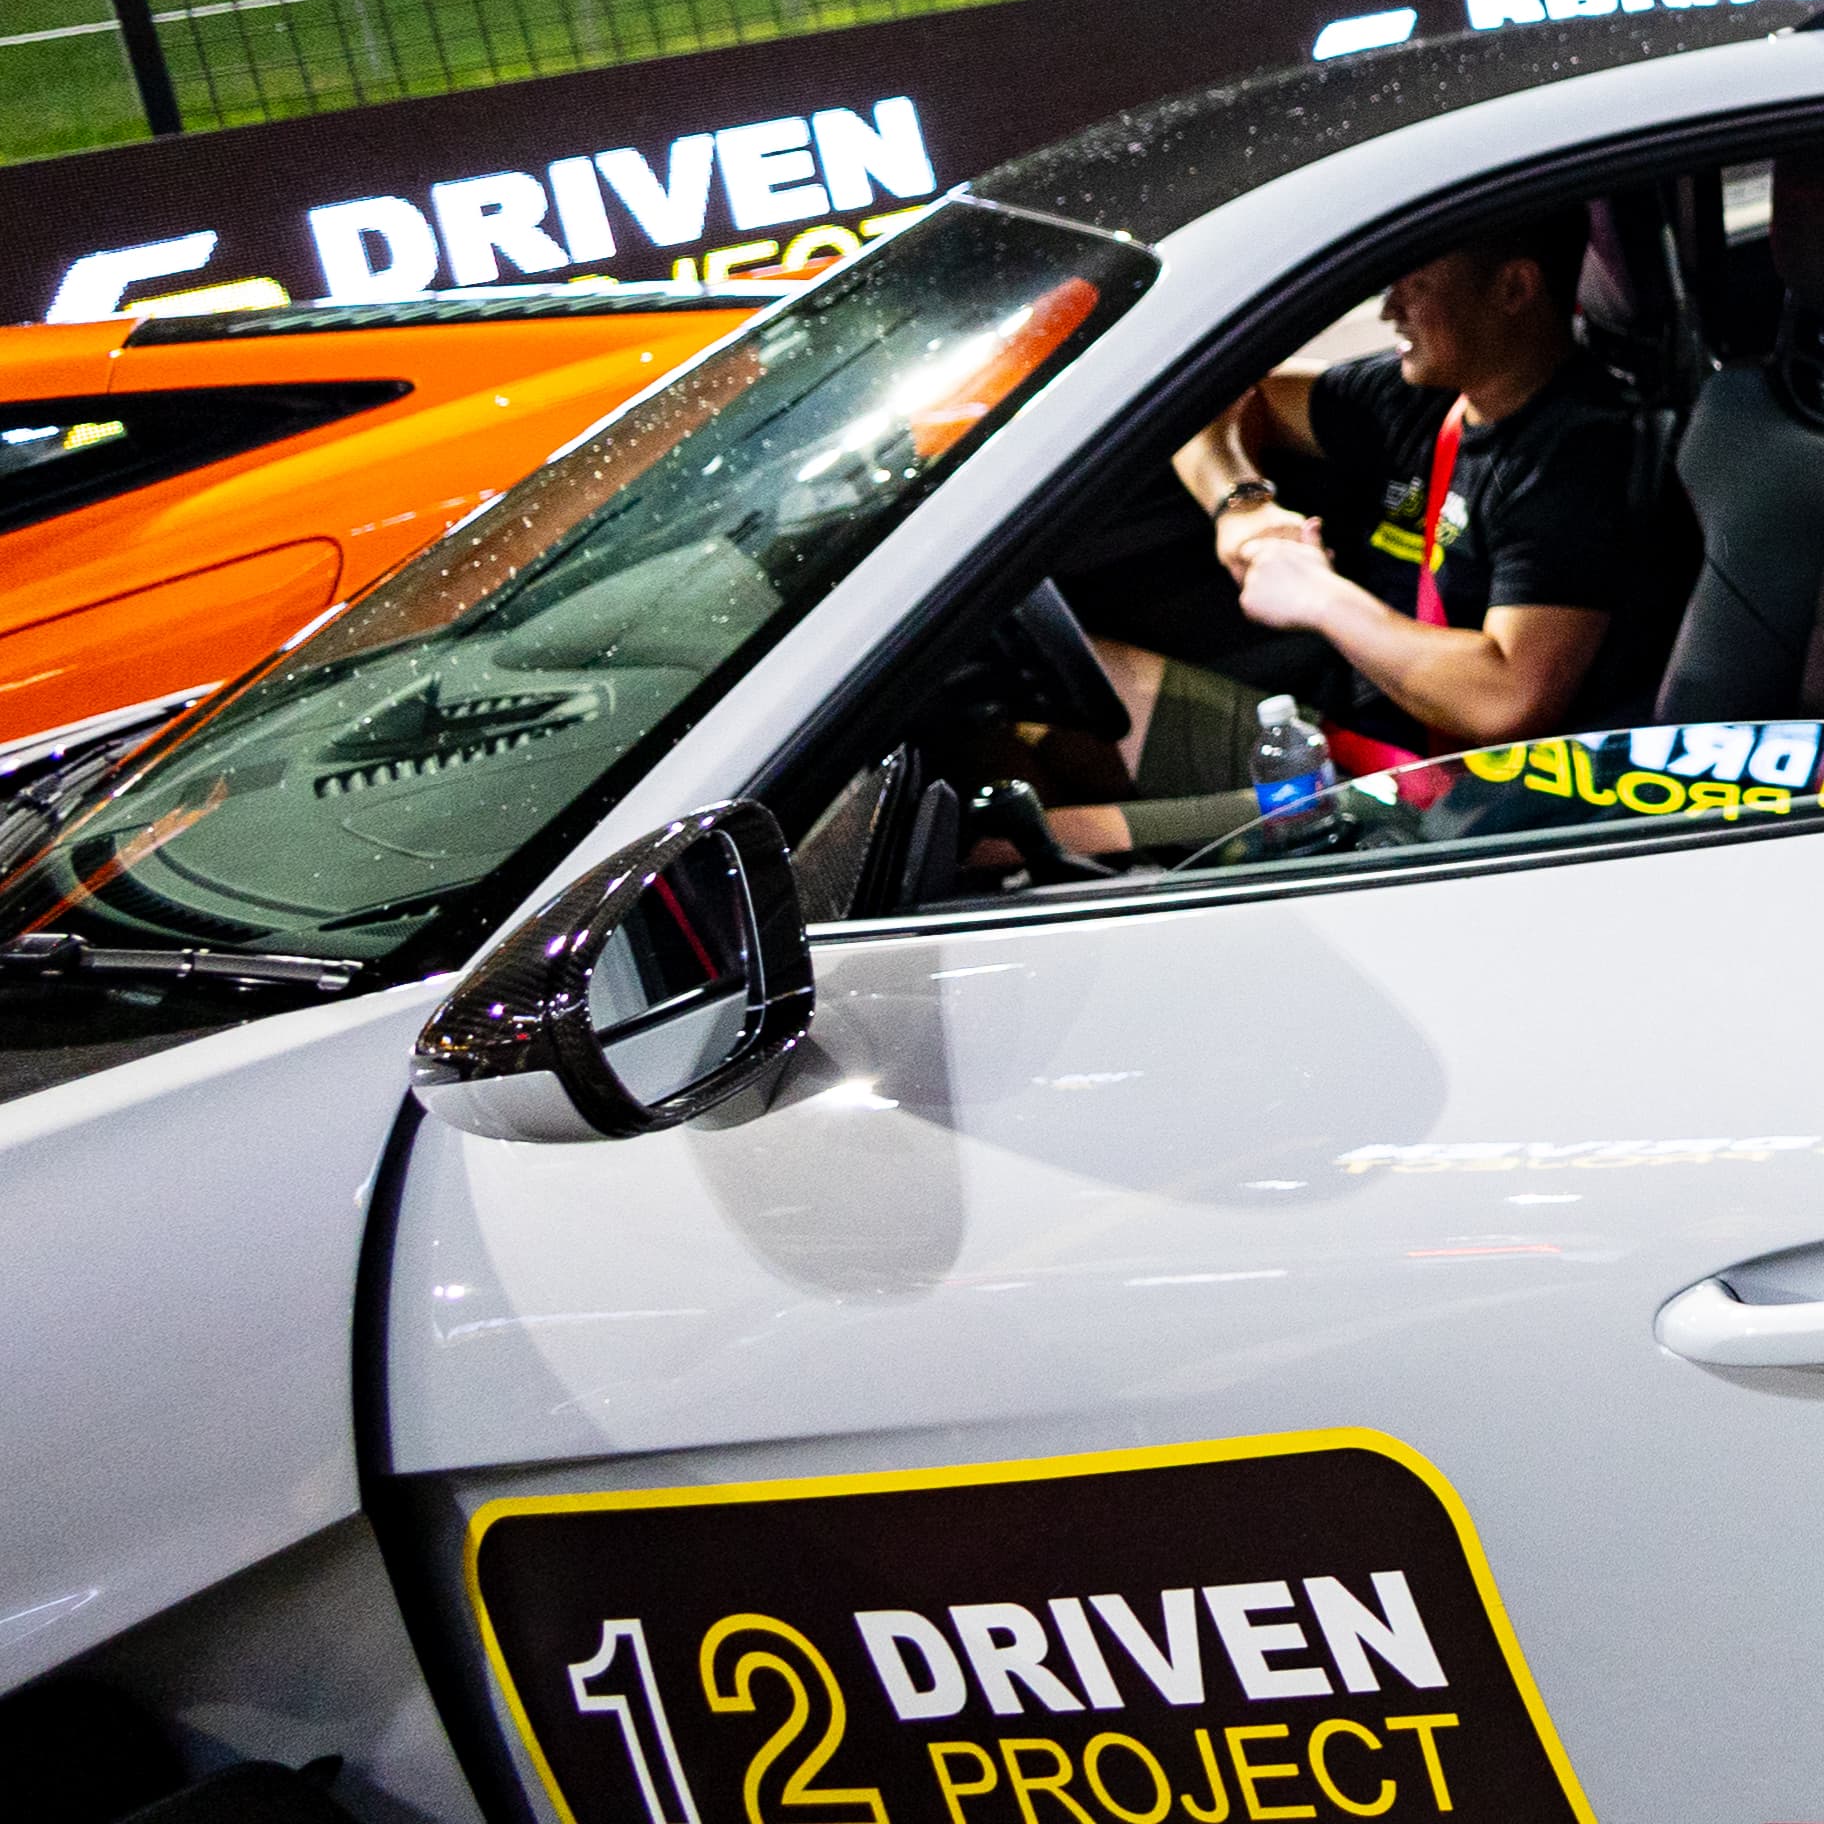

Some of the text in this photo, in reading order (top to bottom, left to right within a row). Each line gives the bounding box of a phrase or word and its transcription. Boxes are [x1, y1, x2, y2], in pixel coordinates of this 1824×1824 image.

[308, 95, 937, 302] DRIVEN
[567, 1612, 883, 1824] 12
[853, 1570, 1449, 1722] DRIVEN
[926, 1713, 1460, 1824] PROJECT
